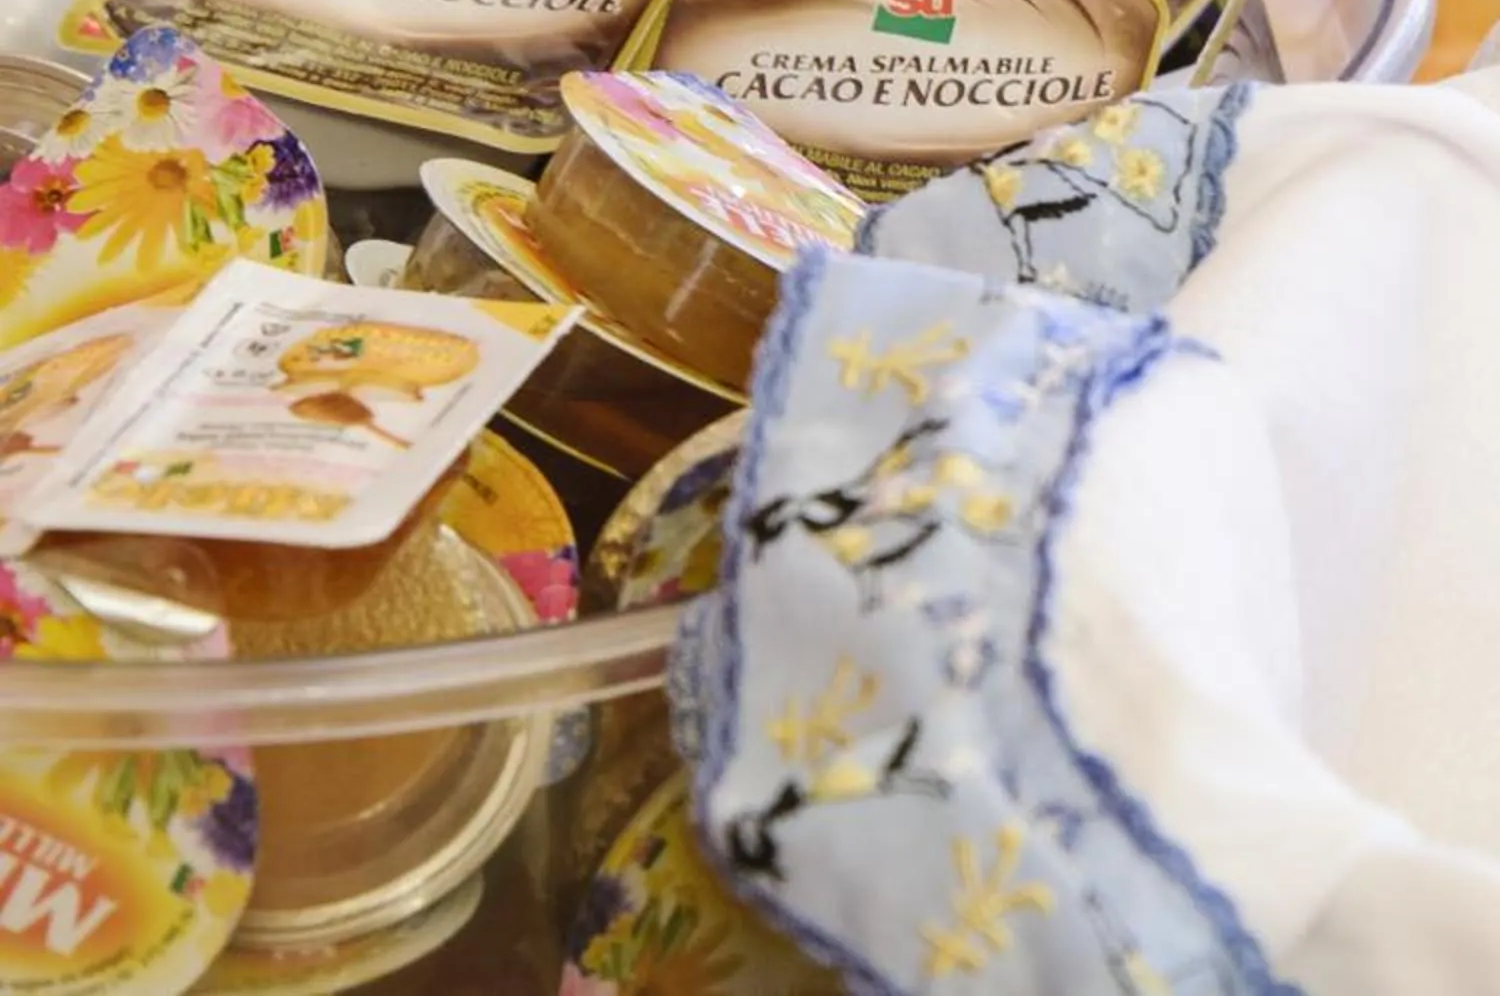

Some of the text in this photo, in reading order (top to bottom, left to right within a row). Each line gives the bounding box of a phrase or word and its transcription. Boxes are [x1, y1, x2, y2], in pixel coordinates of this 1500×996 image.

[751, 52, 1056, 76] CREMA SPALMABILE
[716, 69, 1112, 107] CACAO E NOCCIOLE
